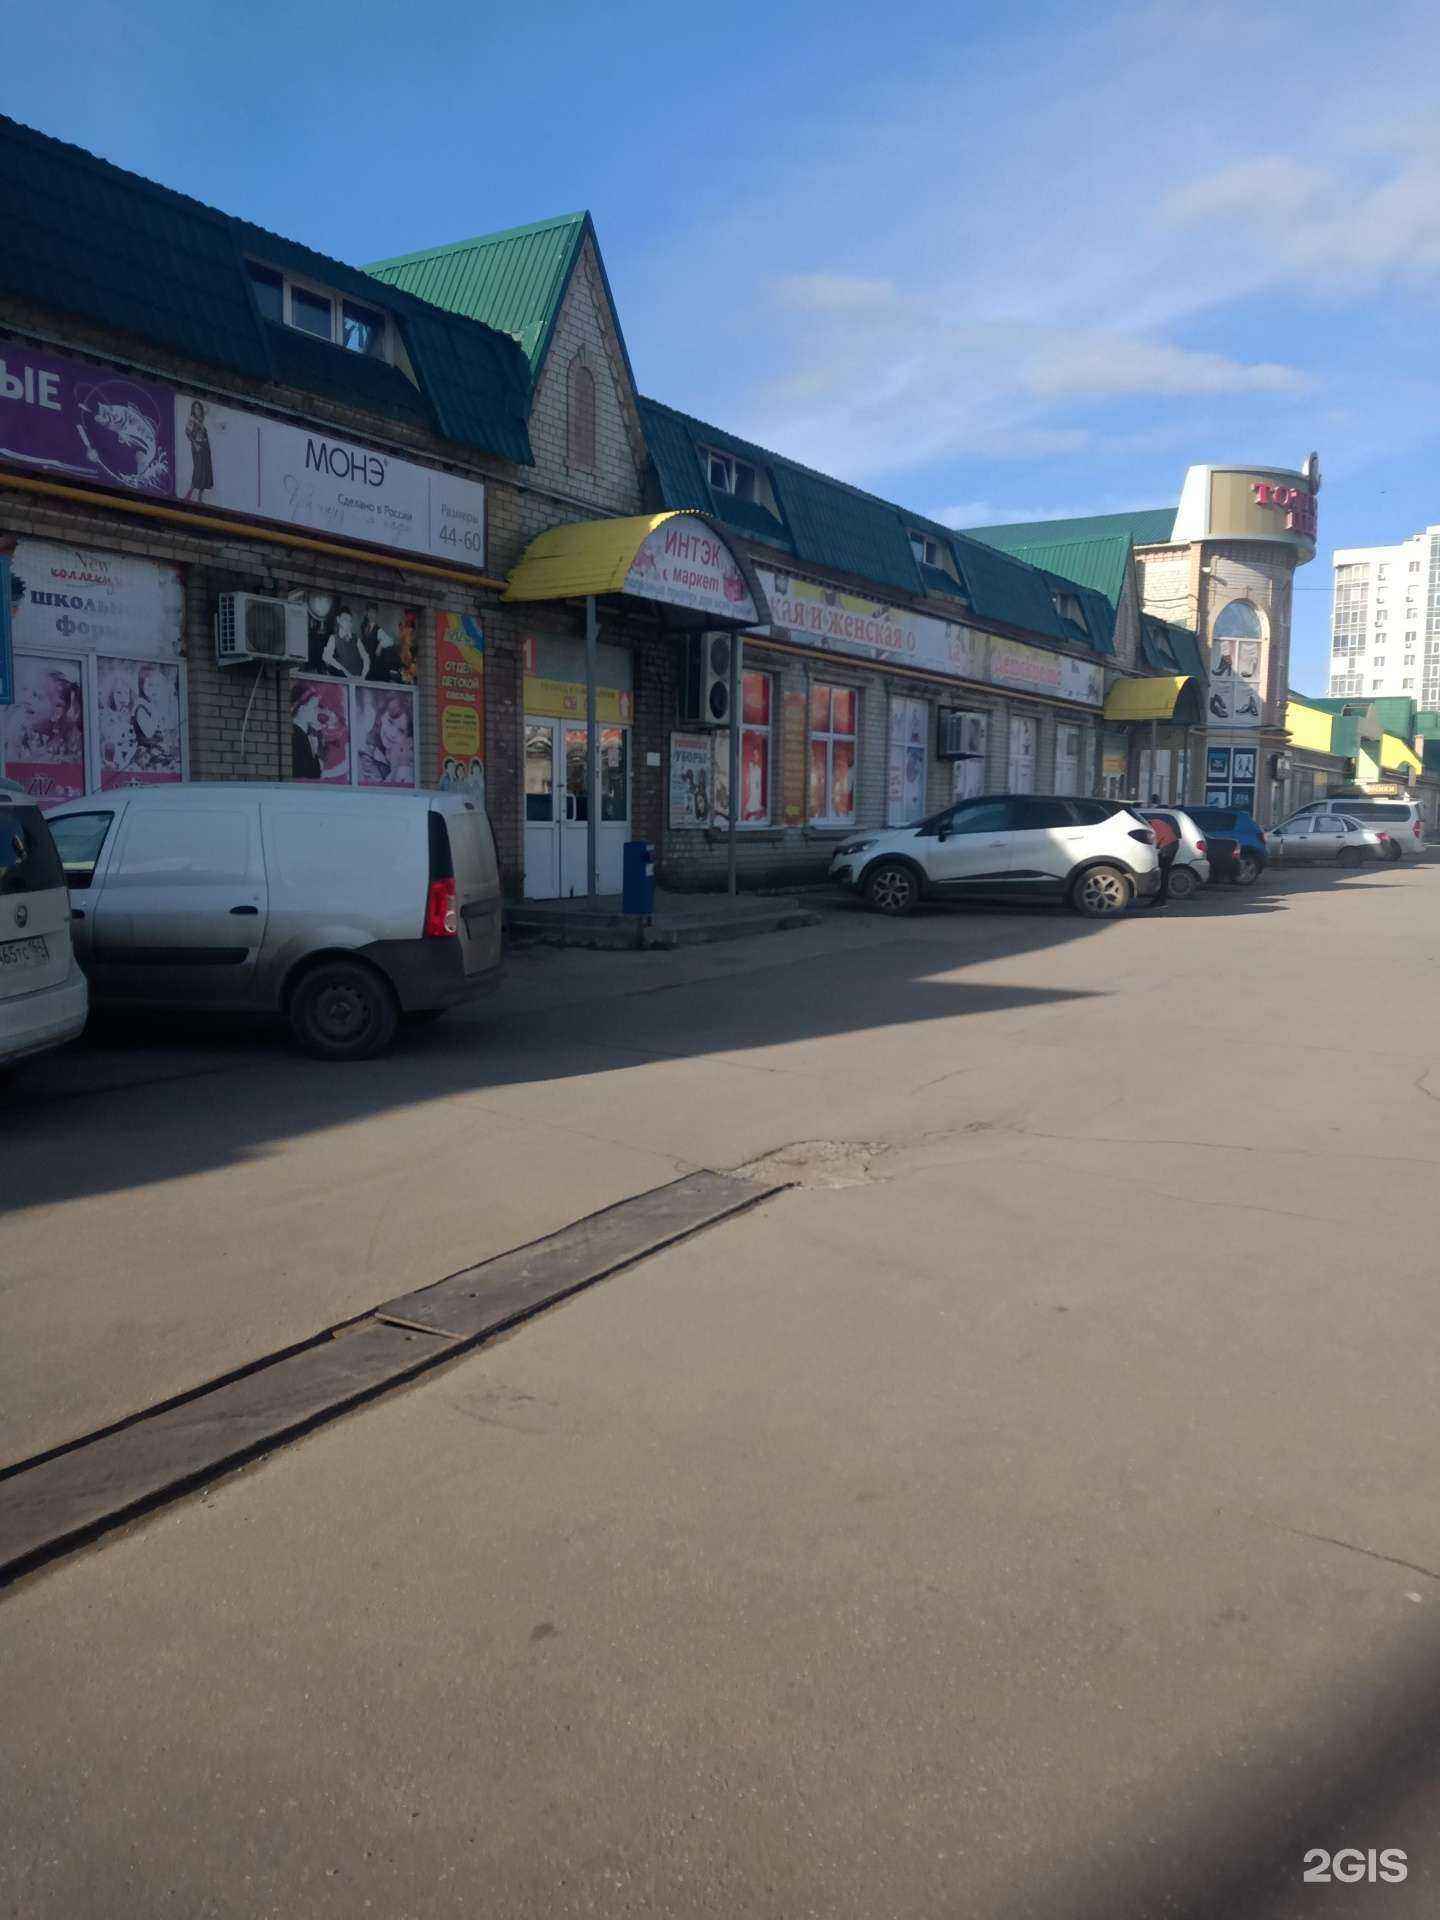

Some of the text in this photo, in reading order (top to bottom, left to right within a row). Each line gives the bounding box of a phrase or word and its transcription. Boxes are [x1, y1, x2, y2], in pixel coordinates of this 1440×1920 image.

[304, 438, 386, 487] МОНЭ
[383, 504, 414, 522] России
[440, 503, 479, 525] Размеры
[438, 525, 482, 553] 44-60
[664, 527, 722, 569] ИНТЭК
[672, 567, 721, 593] маркет
[810, 604, 823, 630] и
[828, 609, 903, 650] женская
